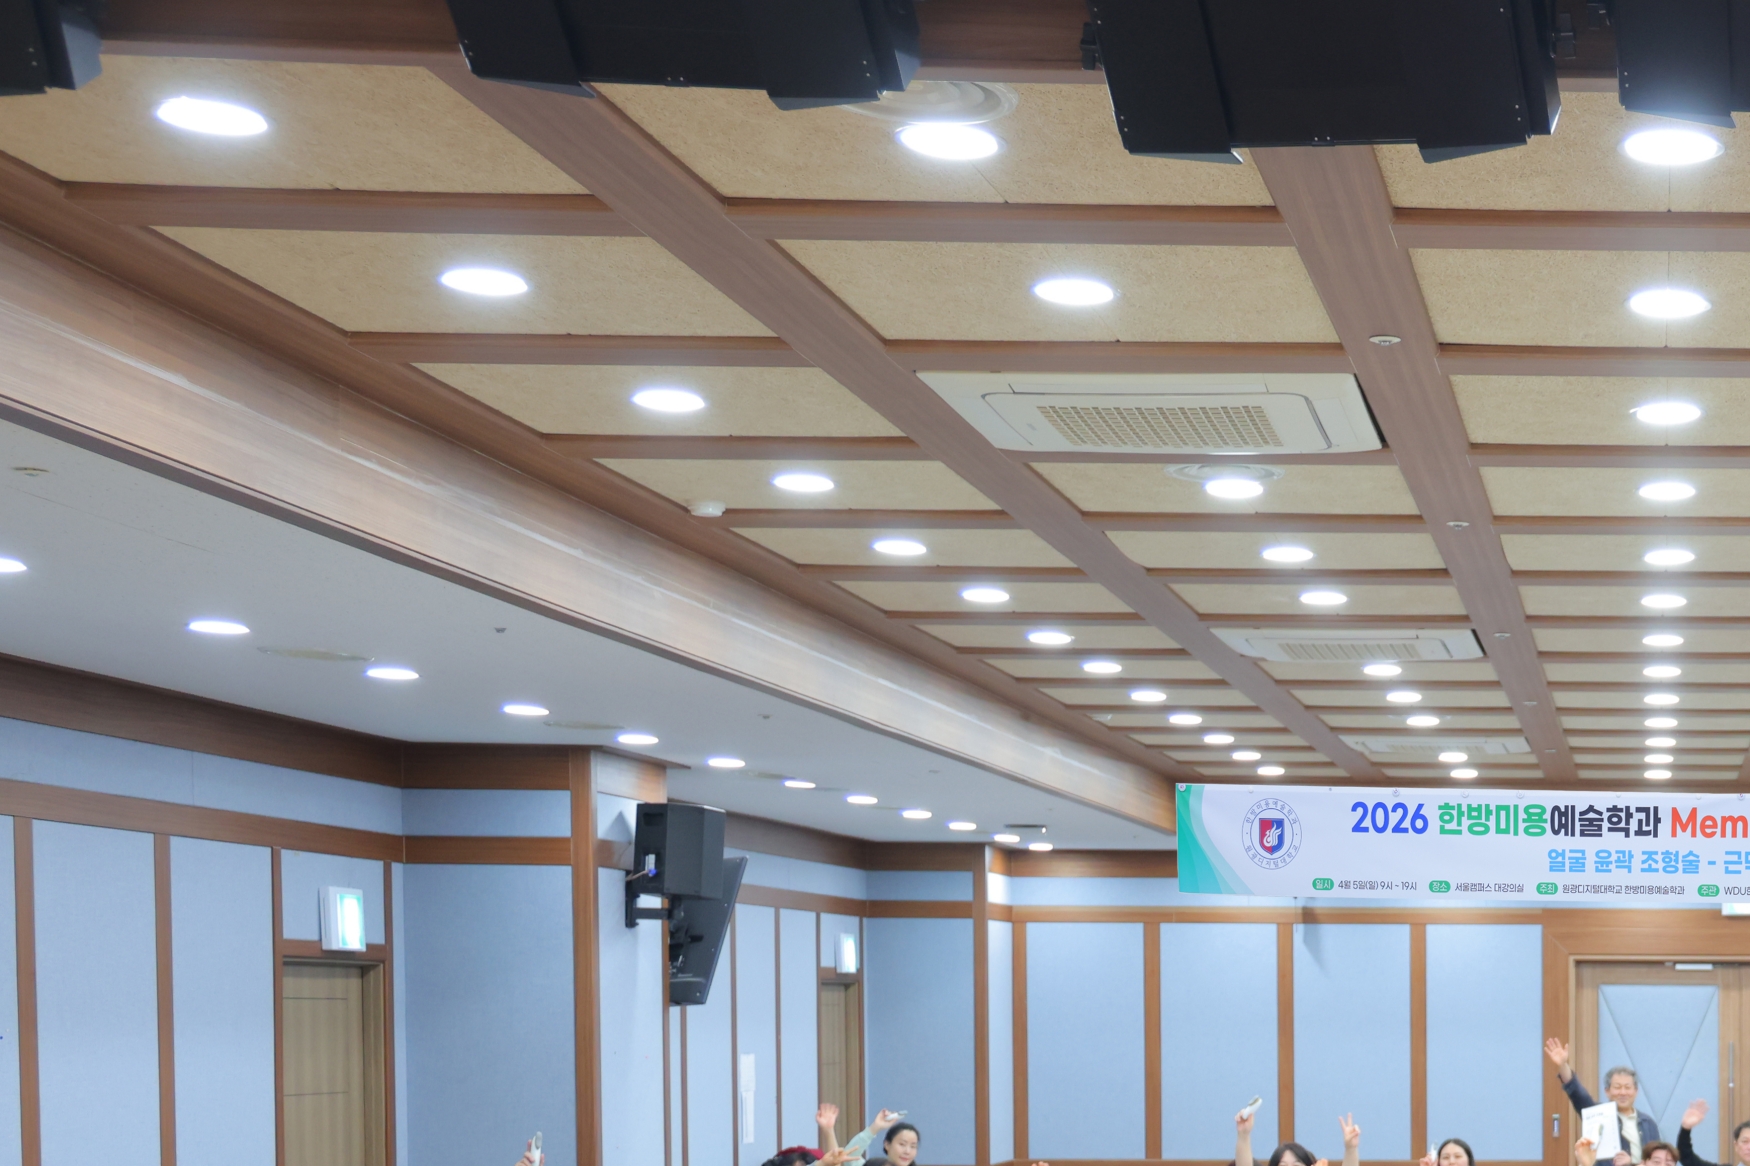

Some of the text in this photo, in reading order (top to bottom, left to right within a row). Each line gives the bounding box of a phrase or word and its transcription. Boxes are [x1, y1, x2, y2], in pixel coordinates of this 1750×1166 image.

[1351, 801, 1429, 835] 2026
[1437, 803, 1662, 838] 한방미용예술학과
[1547, 849, 1587, 873] 얼굴
[1593, 850, 1634, 874] 윤곽
[1640, 850, 1700, 875] 조형술
[1315, 879, 1331, 889] 일시
[1338, 881, 1351, 889] 4월
[1352, 880, 1379, 890] 5일(일)
[1380, 881, 1393, 890] 9시
[1401, 881, 1417, 890] 19시
[1432, 882, 1524, 893] 장소 서울캠퍼스 대강의실
[1540, 883, 1685, 895] 주최 원광디지털대학교 한방미용예술학과
[1701, 886, 1716, 896] 주관
